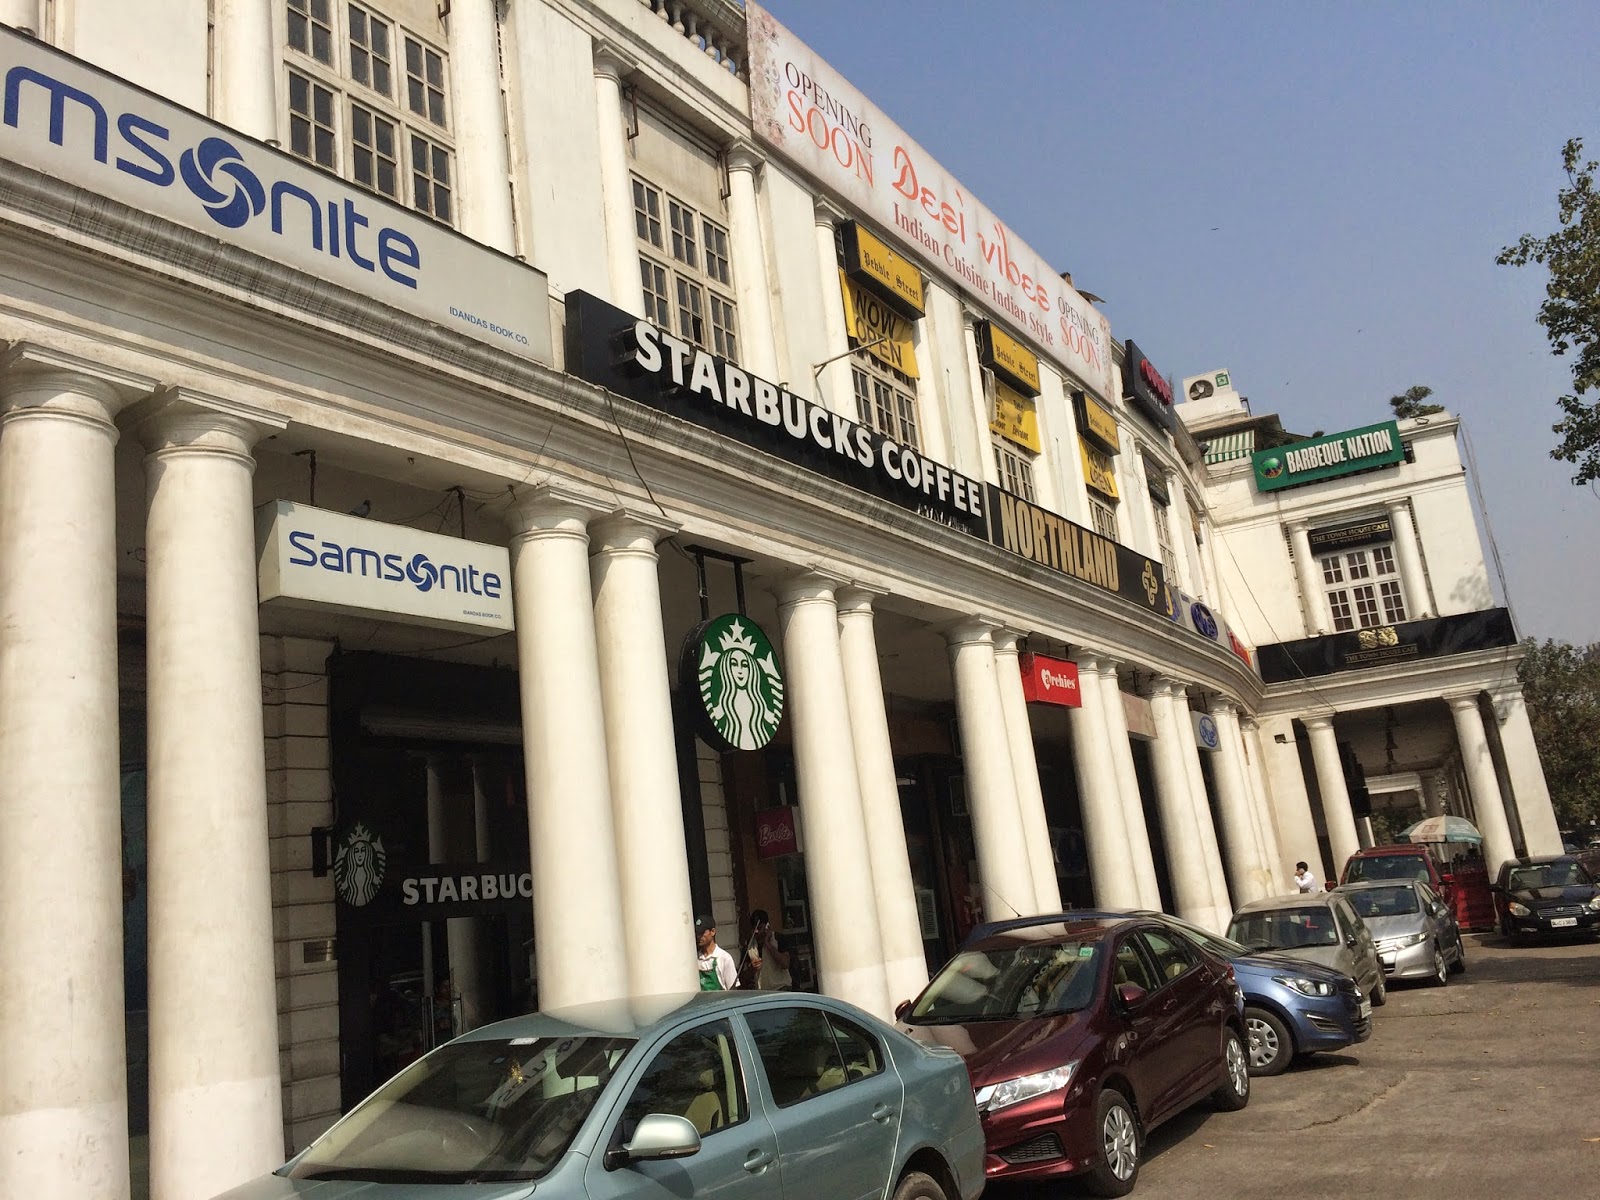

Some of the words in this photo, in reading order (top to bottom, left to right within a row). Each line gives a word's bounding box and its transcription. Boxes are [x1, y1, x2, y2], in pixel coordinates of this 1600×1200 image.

[785, 61, 872, 149] OPENING
[787, 89, 874, 189] SOON
[891, 145, 966, 245] Desi
[863, 249, 890, 281] Pebble
[895, 274, 919, 302] Street
[893, 201, 940, 257] Indian
[943, 243, 989, 295] Cuisine
[991, 280, 1027, 325] Indian
[1029, 311, 1054, 346] Style
[449, 306, 488, 329] IDANDAS
[489, 323, 514, 340] BOOK
[515, 333, 530, 347] CO.
[855, 316, 903, 368] OPEN
[856, 289, 897, 340] NOW
[1057, 296, 1099, 345] OPENING
[1060, 316, 1101, 373] SOON
[634, 320, 875, 469] STARBUCKS
[881, 438, 982, 518] COFFEE
[1285, 439, 1348, 474] BARBEQUE
[1345, 428, 1393, 460] NATION
[999, 490, 1120, 592] NORTHLAND
[1312, 535, 1326, 543] THE
[1326, 530, 1348, 540] TOWN
[1348, 526, 1372, 536] HOUSE
[1372, 522, 1390, 531] CAFE
[288, 530, 502, 599] Samsonite
[759, 822, 794, 847] Barbie
